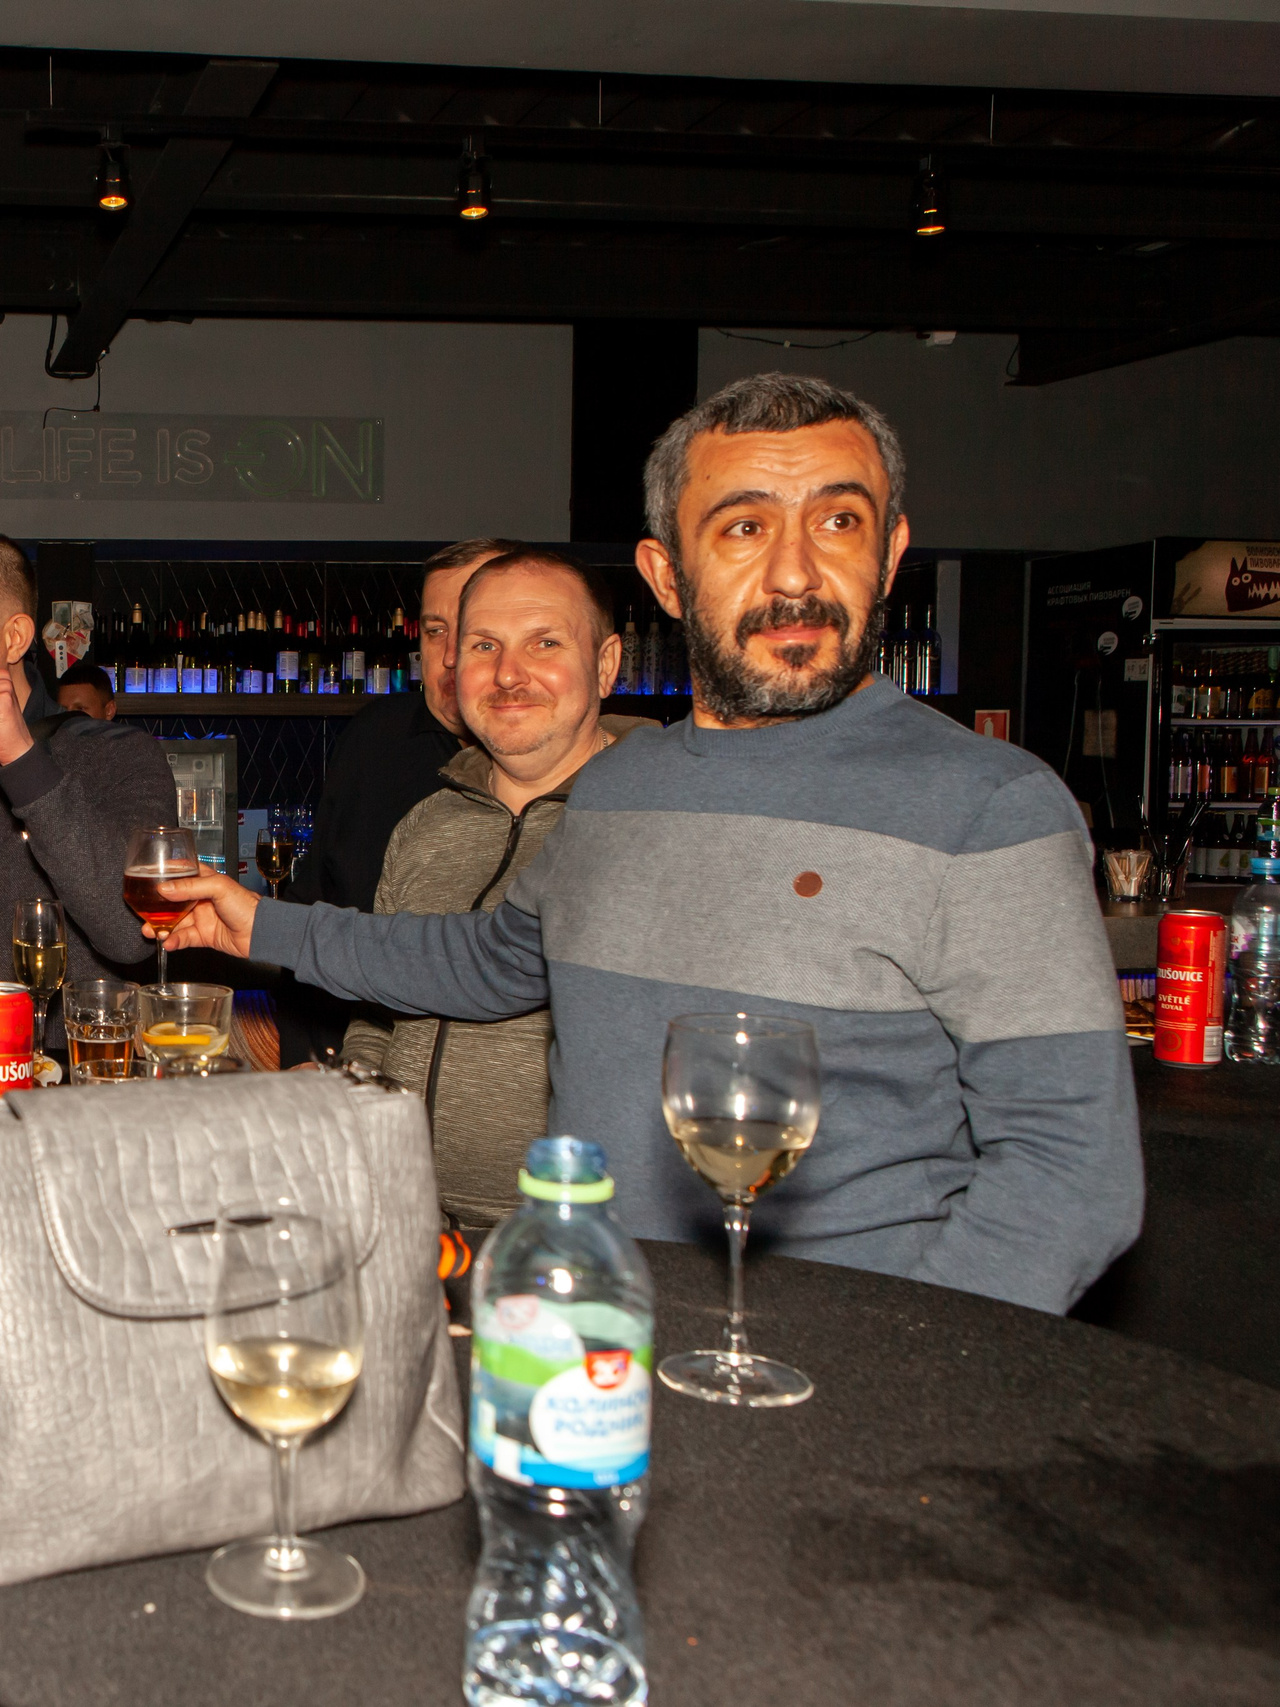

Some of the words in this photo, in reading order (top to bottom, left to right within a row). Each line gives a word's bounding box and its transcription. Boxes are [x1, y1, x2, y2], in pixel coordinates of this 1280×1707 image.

[0, 426, 142, 484] LIFE
[156, 428, 214, 485] IS
[1047, 581, 1091, 595] АССОЦИАЦИЯ
[1046, 593, 1089, 607] КРАФТОВЫХ
[1089, 588, 1132, 601] ПИВОВАРЕН
[1158, 993, 1191, 1005] SVĚTLÉ
[1161, 1003, 1184, 1011] ROYAL
